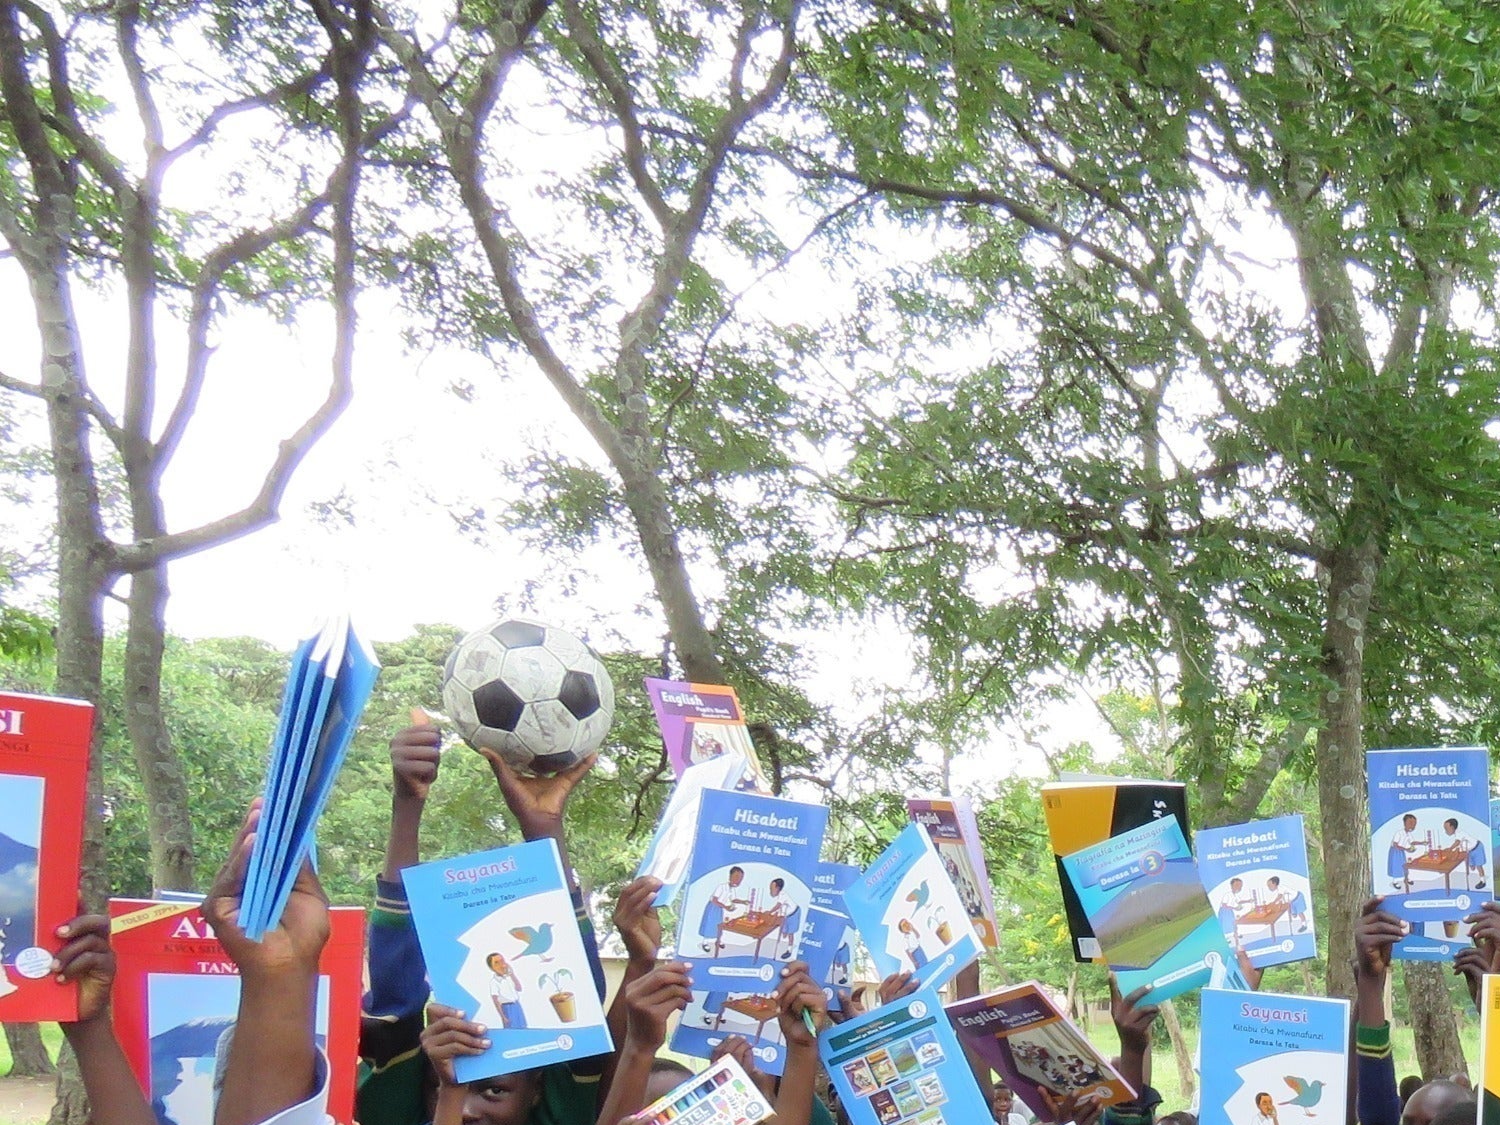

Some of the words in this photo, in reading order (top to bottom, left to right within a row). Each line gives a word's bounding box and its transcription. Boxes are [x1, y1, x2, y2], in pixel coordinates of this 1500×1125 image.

[660, 690, 705, 707] English
[1396, 763, 1459, 777] Hisabati
[1378, 781, 1406, 789] Kitabu
[1407, 780, 1421, 788] cha
[1422, 779, 1472, 788] Mwanafunzi
[1398, 792, 1428, 801] Darasa
[1440, 791, 1458, 800] Tatu
[733, 808, 799, 831] Hisabati
[711, 824, 741, 836] Kitabu
[742, 828, 758, 839] cha
[758, 831, 808, 846] Mwanafunzi
[1222, 829, 1278, 848] Hisabati
[730, 840, 761, 853] Darasa
[763, 845, 772, 854] la
[774, 847, 792, 857] Tatu
[1207, 852, 1231, 861] Kitabu
[1232, 848, 1246, 857] cha
[444, 855, 519, 885] Sayansi
[1100, 870, 1130, 887] Darasa
[1130, 864, 1141, 874] la
[1145, 855, 1158, 871] 3
[1225, 857, 1252, 868] Darasa
[957, 1007, 1008, 1027] English
[1240, 1002, 1308, 1024] Sayansi
[1232, 1023, 1258, 1033] Kitabu
[1260, 1026, 1275, 1035] cha
[1276, 1028, 1325, 1041] Mwanafunzi
[1249, 1037, 1274, 1047] Darasa
[1275, 1040, 1283, 1048] la
[1284, 1041, 1300, 1049] Tatu
[747, 1103, 761, 1116] 10
